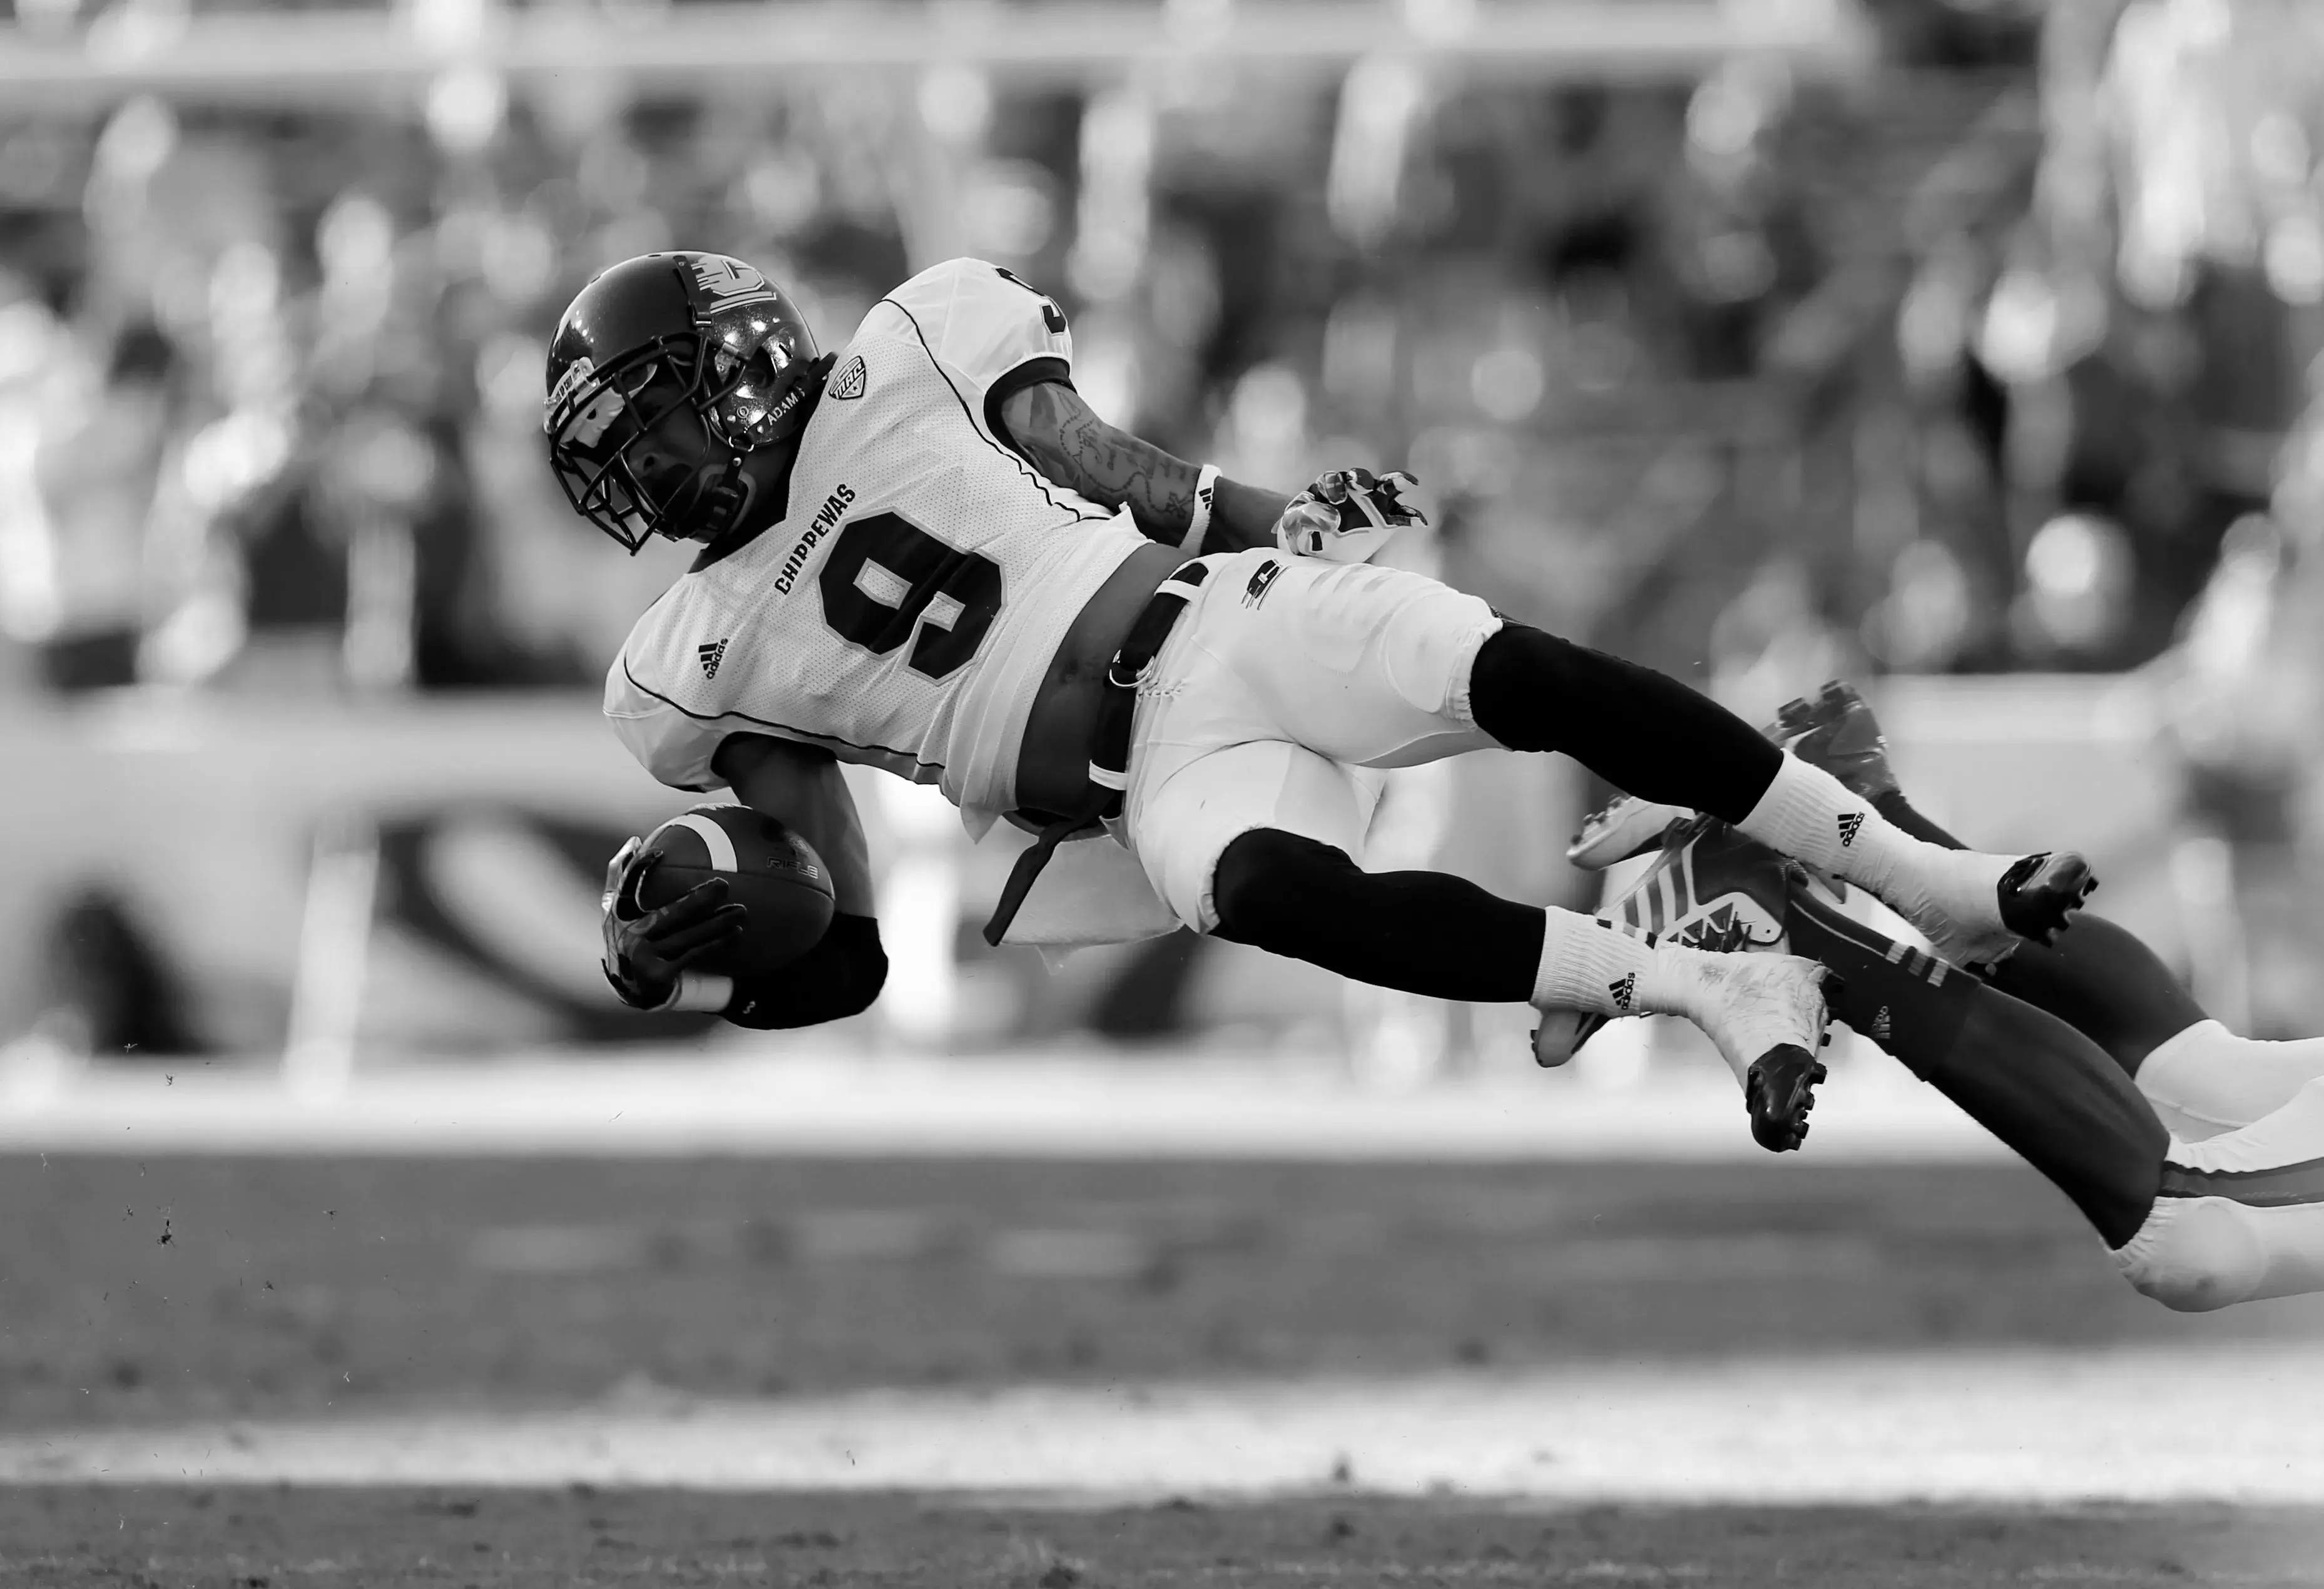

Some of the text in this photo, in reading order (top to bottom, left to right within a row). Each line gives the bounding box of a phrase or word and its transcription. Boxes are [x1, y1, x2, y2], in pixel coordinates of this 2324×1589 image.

[833, 362, 865, 399] MAC
[774, 484, 855, 595] CHIPPEWAS
[815, 507, 1008, 687] 9
[706, 638, 728, 680] adidas
[1842, 812, 1865, 847] adidas
[1621, 972, 1635, 1010] adidas
